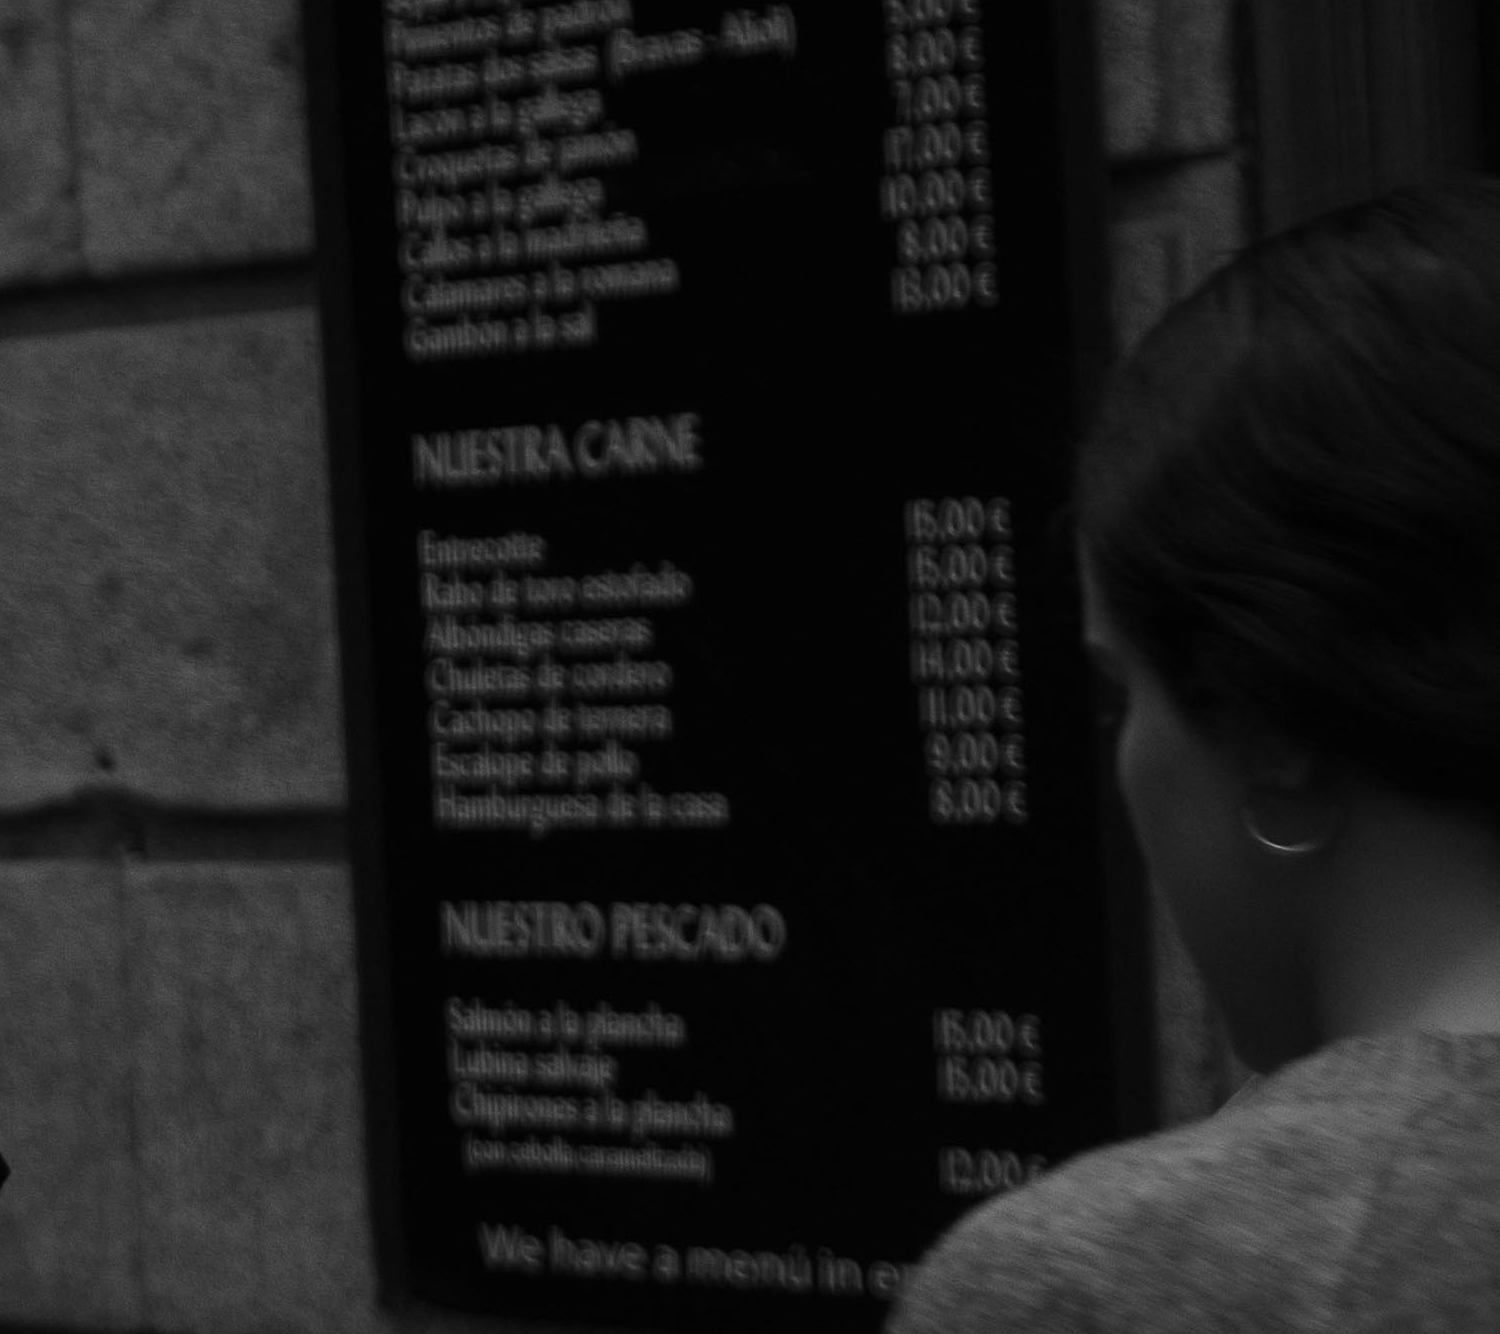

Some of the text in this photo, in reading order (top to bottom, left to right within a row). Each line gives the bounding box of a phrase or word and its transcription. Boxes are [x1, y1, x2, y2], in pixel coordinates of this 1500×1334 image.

[411, 411, 704, 489] NUESTRA CARNE
[441, 900, 786, 962] NUESTRO PESCADO
[478, 1221, 547, 1278] We
[548, 1225, 648, 1283] have
[652, 1244, 683, 1283] a
[686, 1244, 812, 1296] menú
[816, 1247, 864, 1298] in
